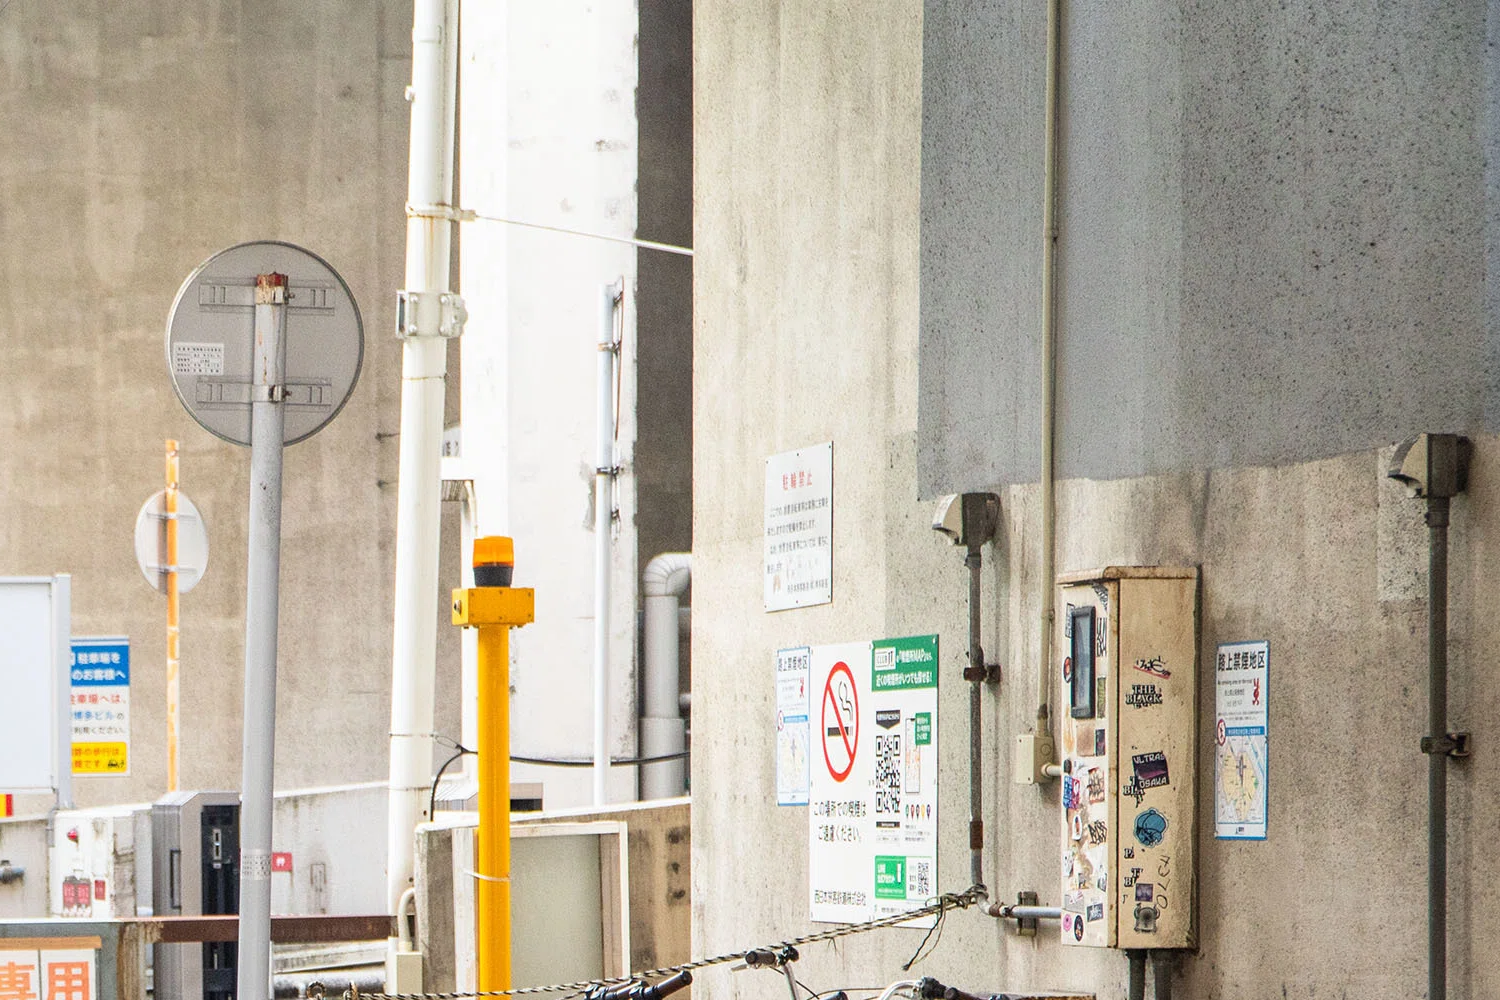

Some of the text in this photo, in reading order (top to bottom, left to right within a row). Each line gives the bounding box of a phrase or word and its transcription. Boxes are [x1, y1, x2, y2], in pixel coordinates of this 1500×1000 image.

[1217, 650, 1266, 672] 路上禁煙地区
[1132, 684, 1157, 694] THE
